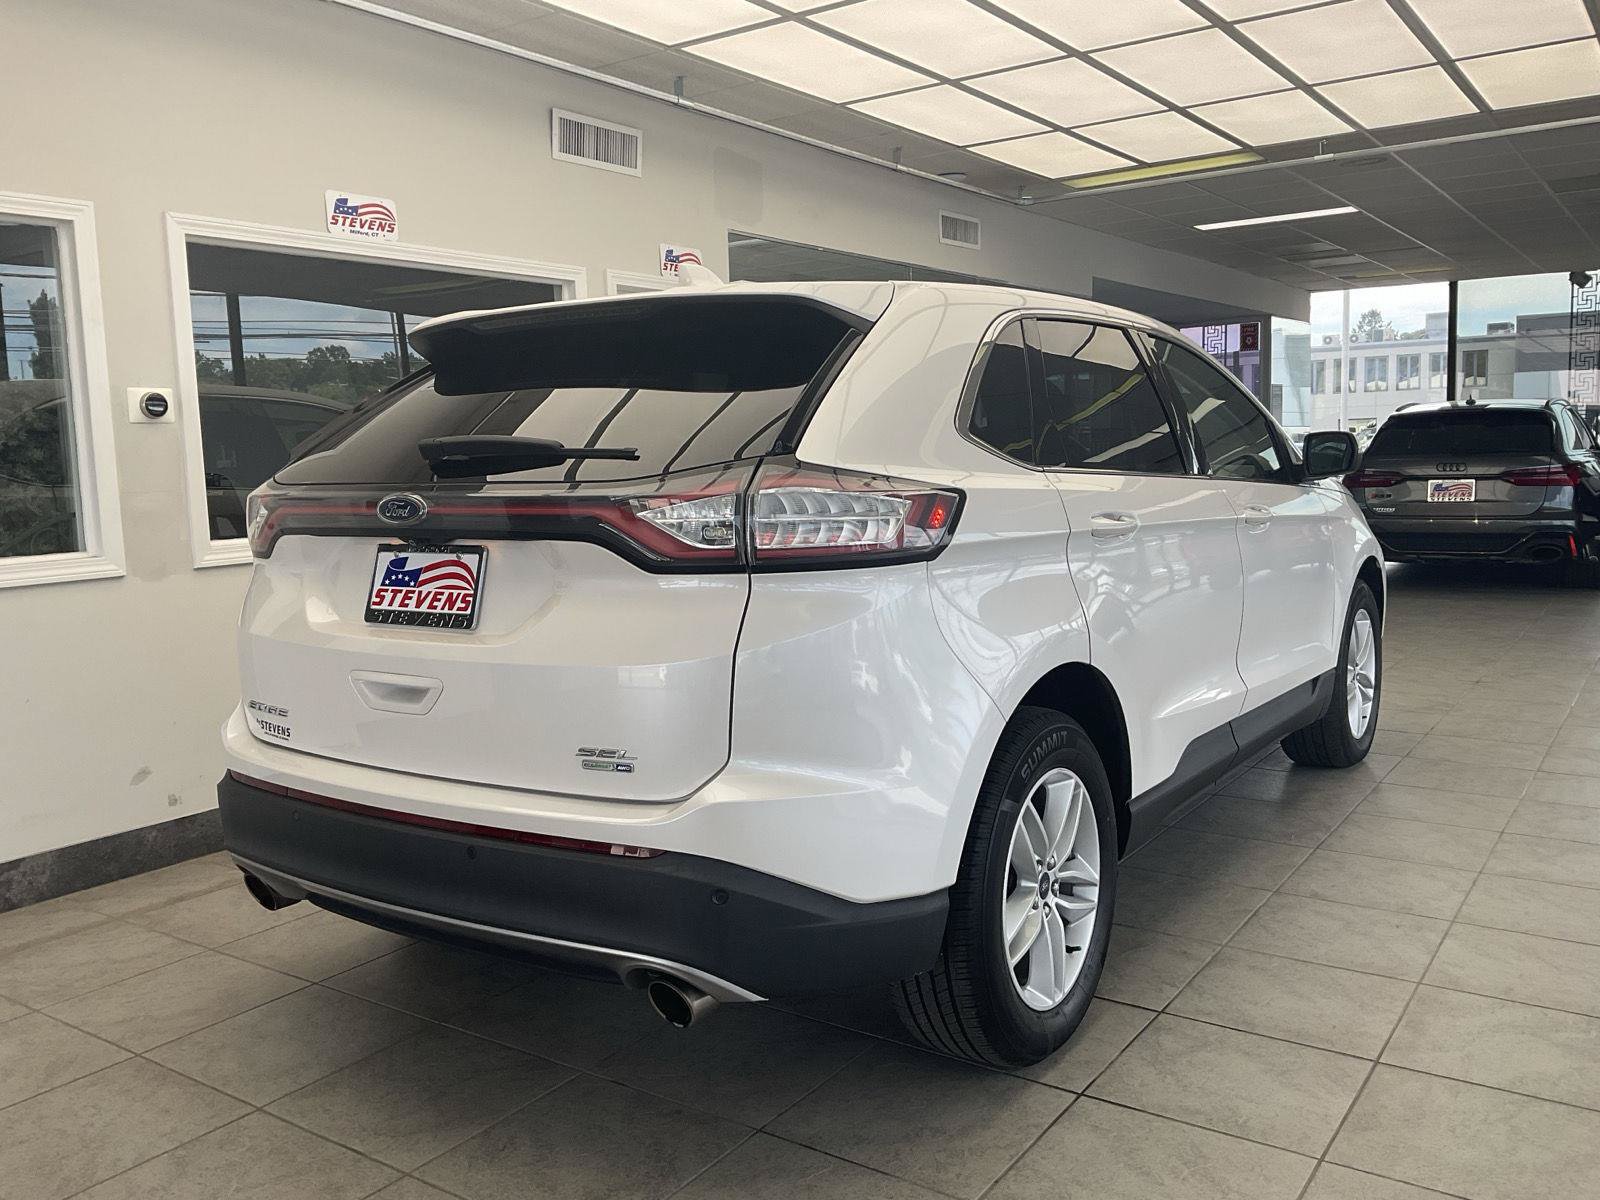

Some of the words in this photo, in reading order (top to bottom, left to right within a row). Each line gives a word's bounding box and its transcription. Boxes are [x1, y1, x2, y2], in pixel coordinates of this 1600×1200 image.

[330, 214, 396, 233] STEVENS
[385, 501, 411, 517] Ford
[371, 588, 474, 612] STEVENS
[373, 609, 468, 629] STEVENS
[248, 699, 288, 717] EDGE
[260, 720, 291, 738] STEVENS
[575, 747, 638, 760] SEL
[1021, 731, 1068, 783] SUMMIT
